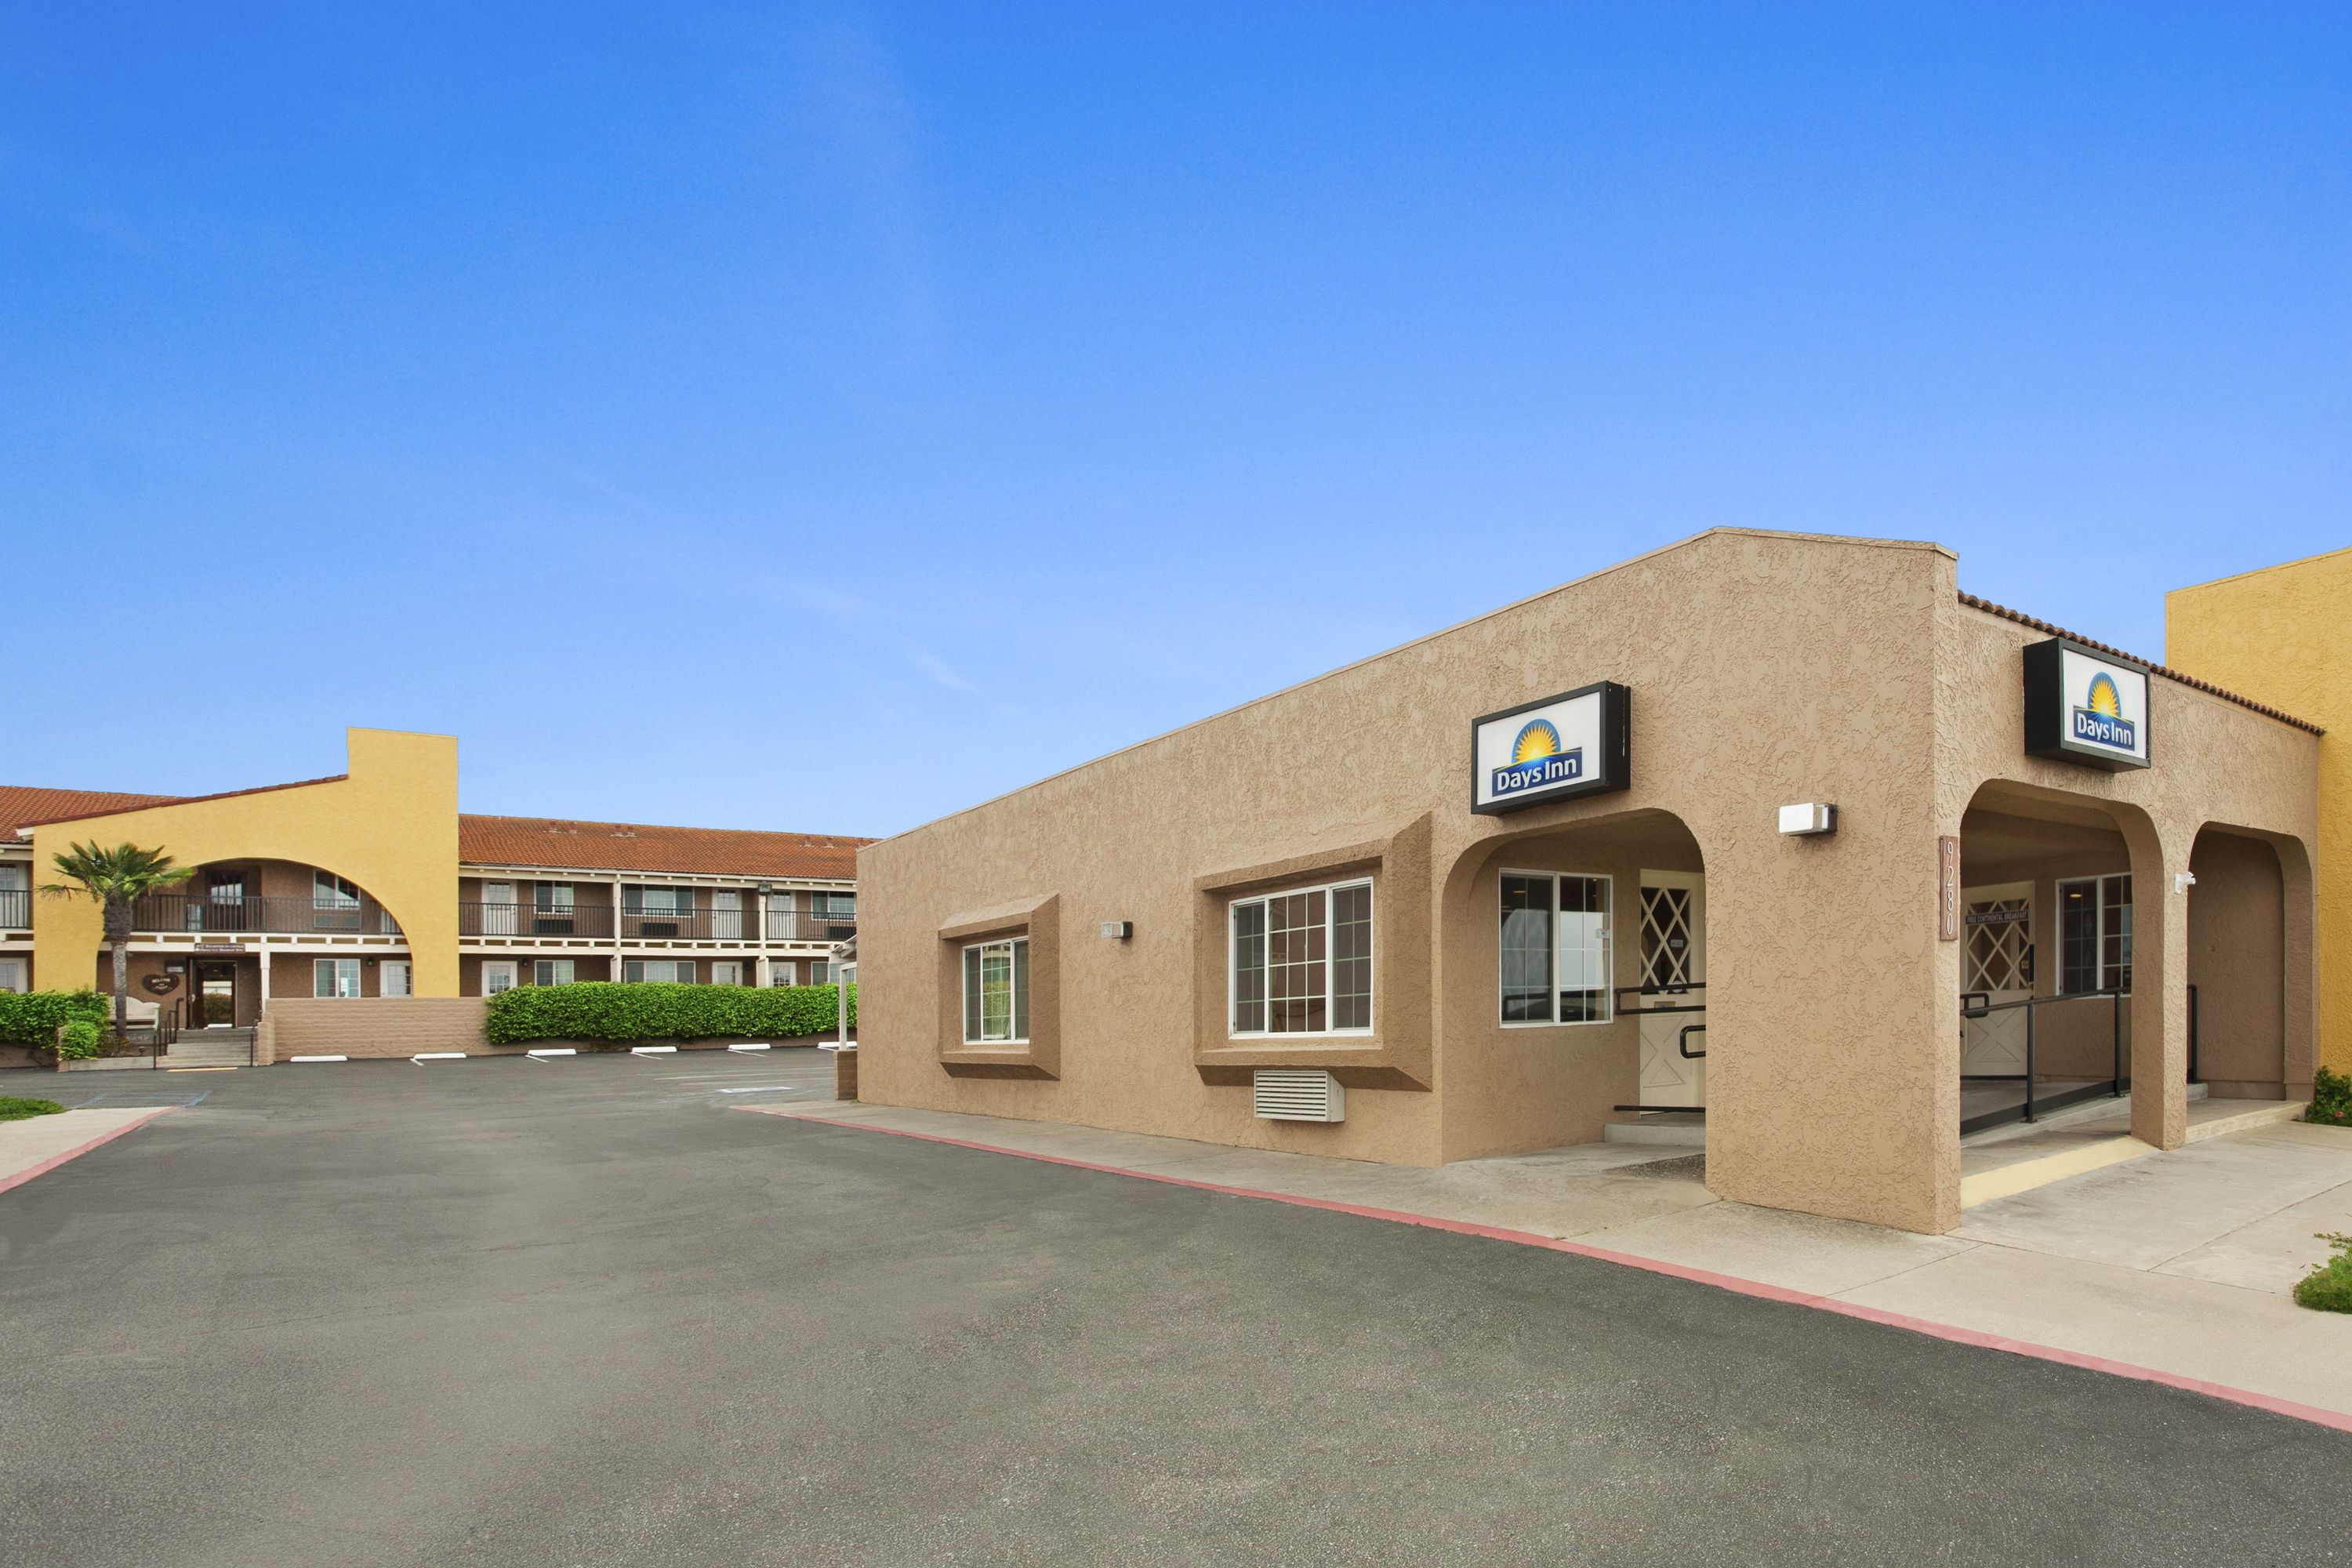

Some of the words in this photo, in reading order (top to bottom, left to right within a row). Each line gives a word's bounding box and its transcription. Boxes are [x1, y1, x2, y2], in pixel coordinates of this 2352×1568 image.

[2078, 713, 2110, 740] Days
[2111, 721, 2132, 745] Inn
[1497, 767, 1542, 791] Days
[1544, 758, 1577, 779] Inn
[1976, 913, 2003, 923] CONTINENTAL
[2004, 910, 2027, 920] BREAKFAST
